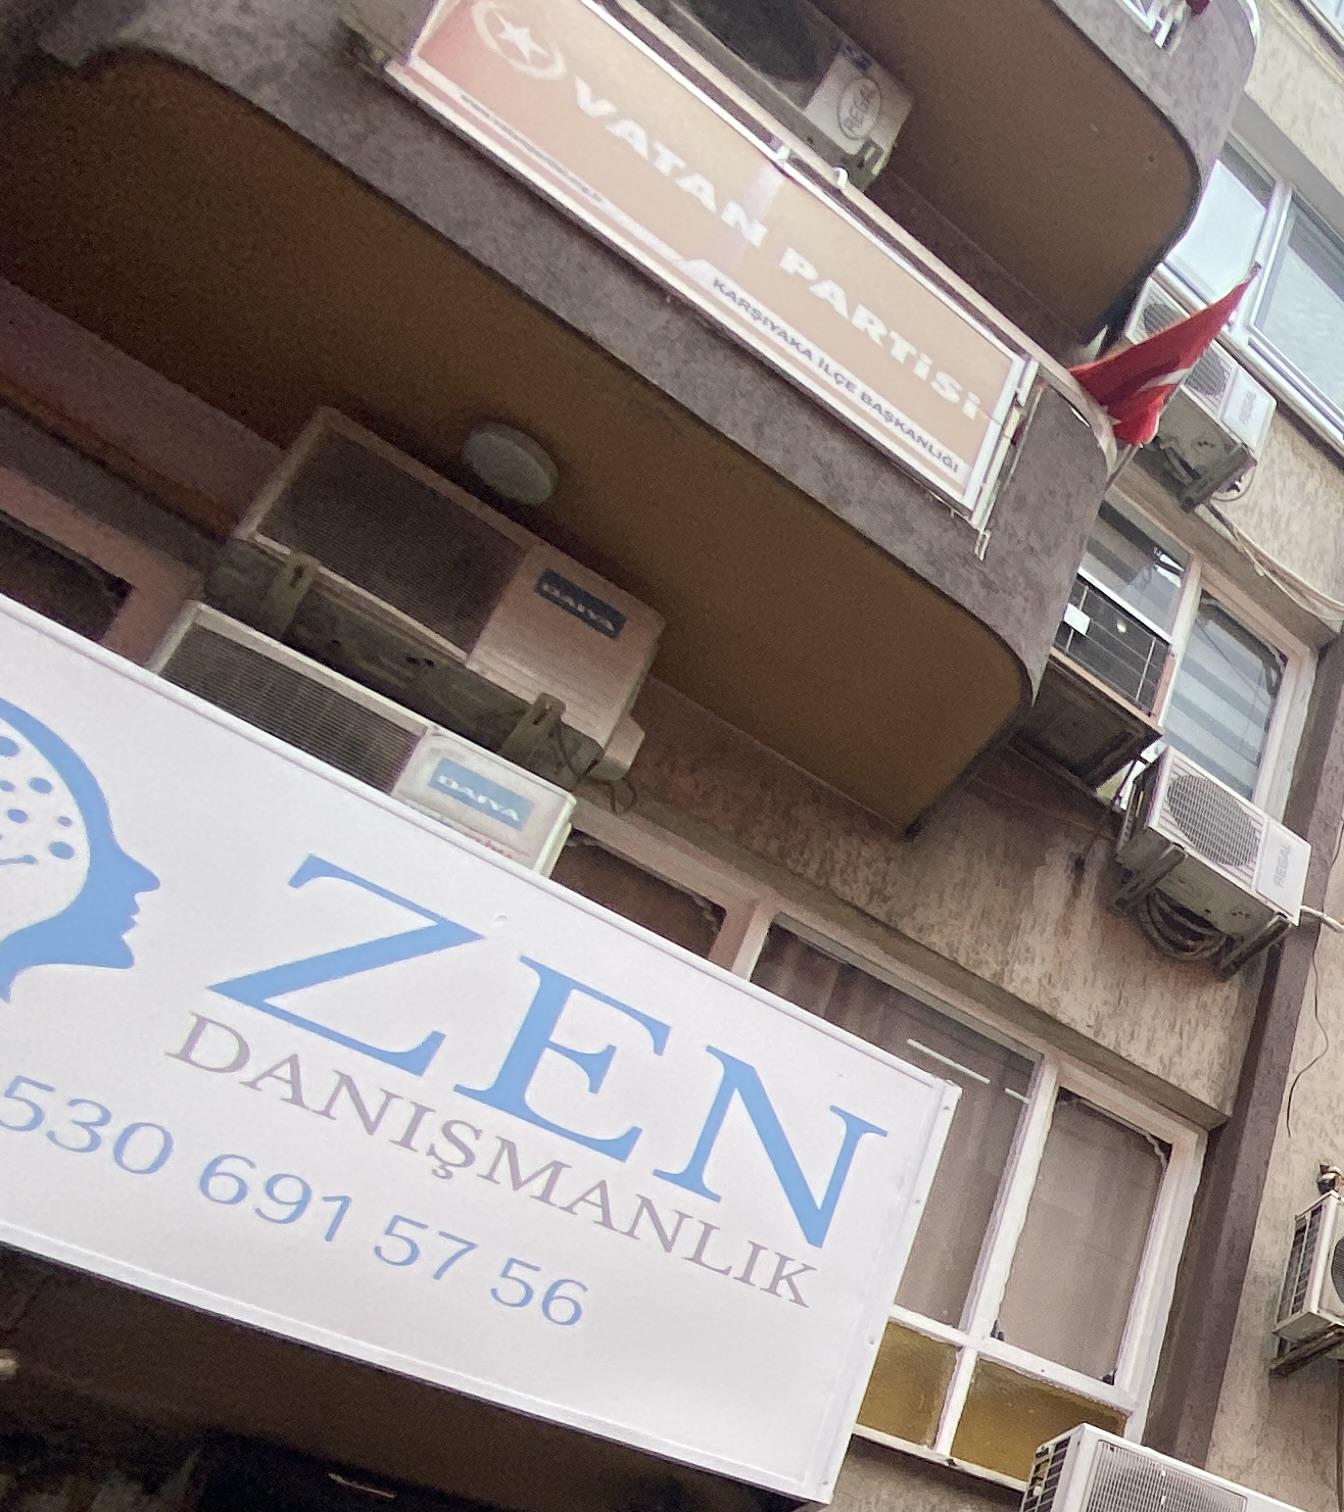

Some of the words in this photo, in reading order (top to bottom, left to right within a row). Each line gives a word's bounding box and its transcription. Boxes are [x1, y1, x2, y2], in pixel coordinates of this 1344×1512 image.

[573, 77, 769, 249] VATAN
[778, 245, 984, 421] PARTİSİ
[711, 276, 815, 363] KARŞIYAKA
[815, 356, 858, 398] İLÇE
[859, 390, 961, 475] BAŞKANLIĞI
[166, 1012, 820, 1310] DANIŞMANLIK
[207, 853, 889, 1249] ZEN
[197, 1151, 353, 1243] 691
[372, 1213, 479, 1281] 57
[488, 1256, 591, 1329] 56
